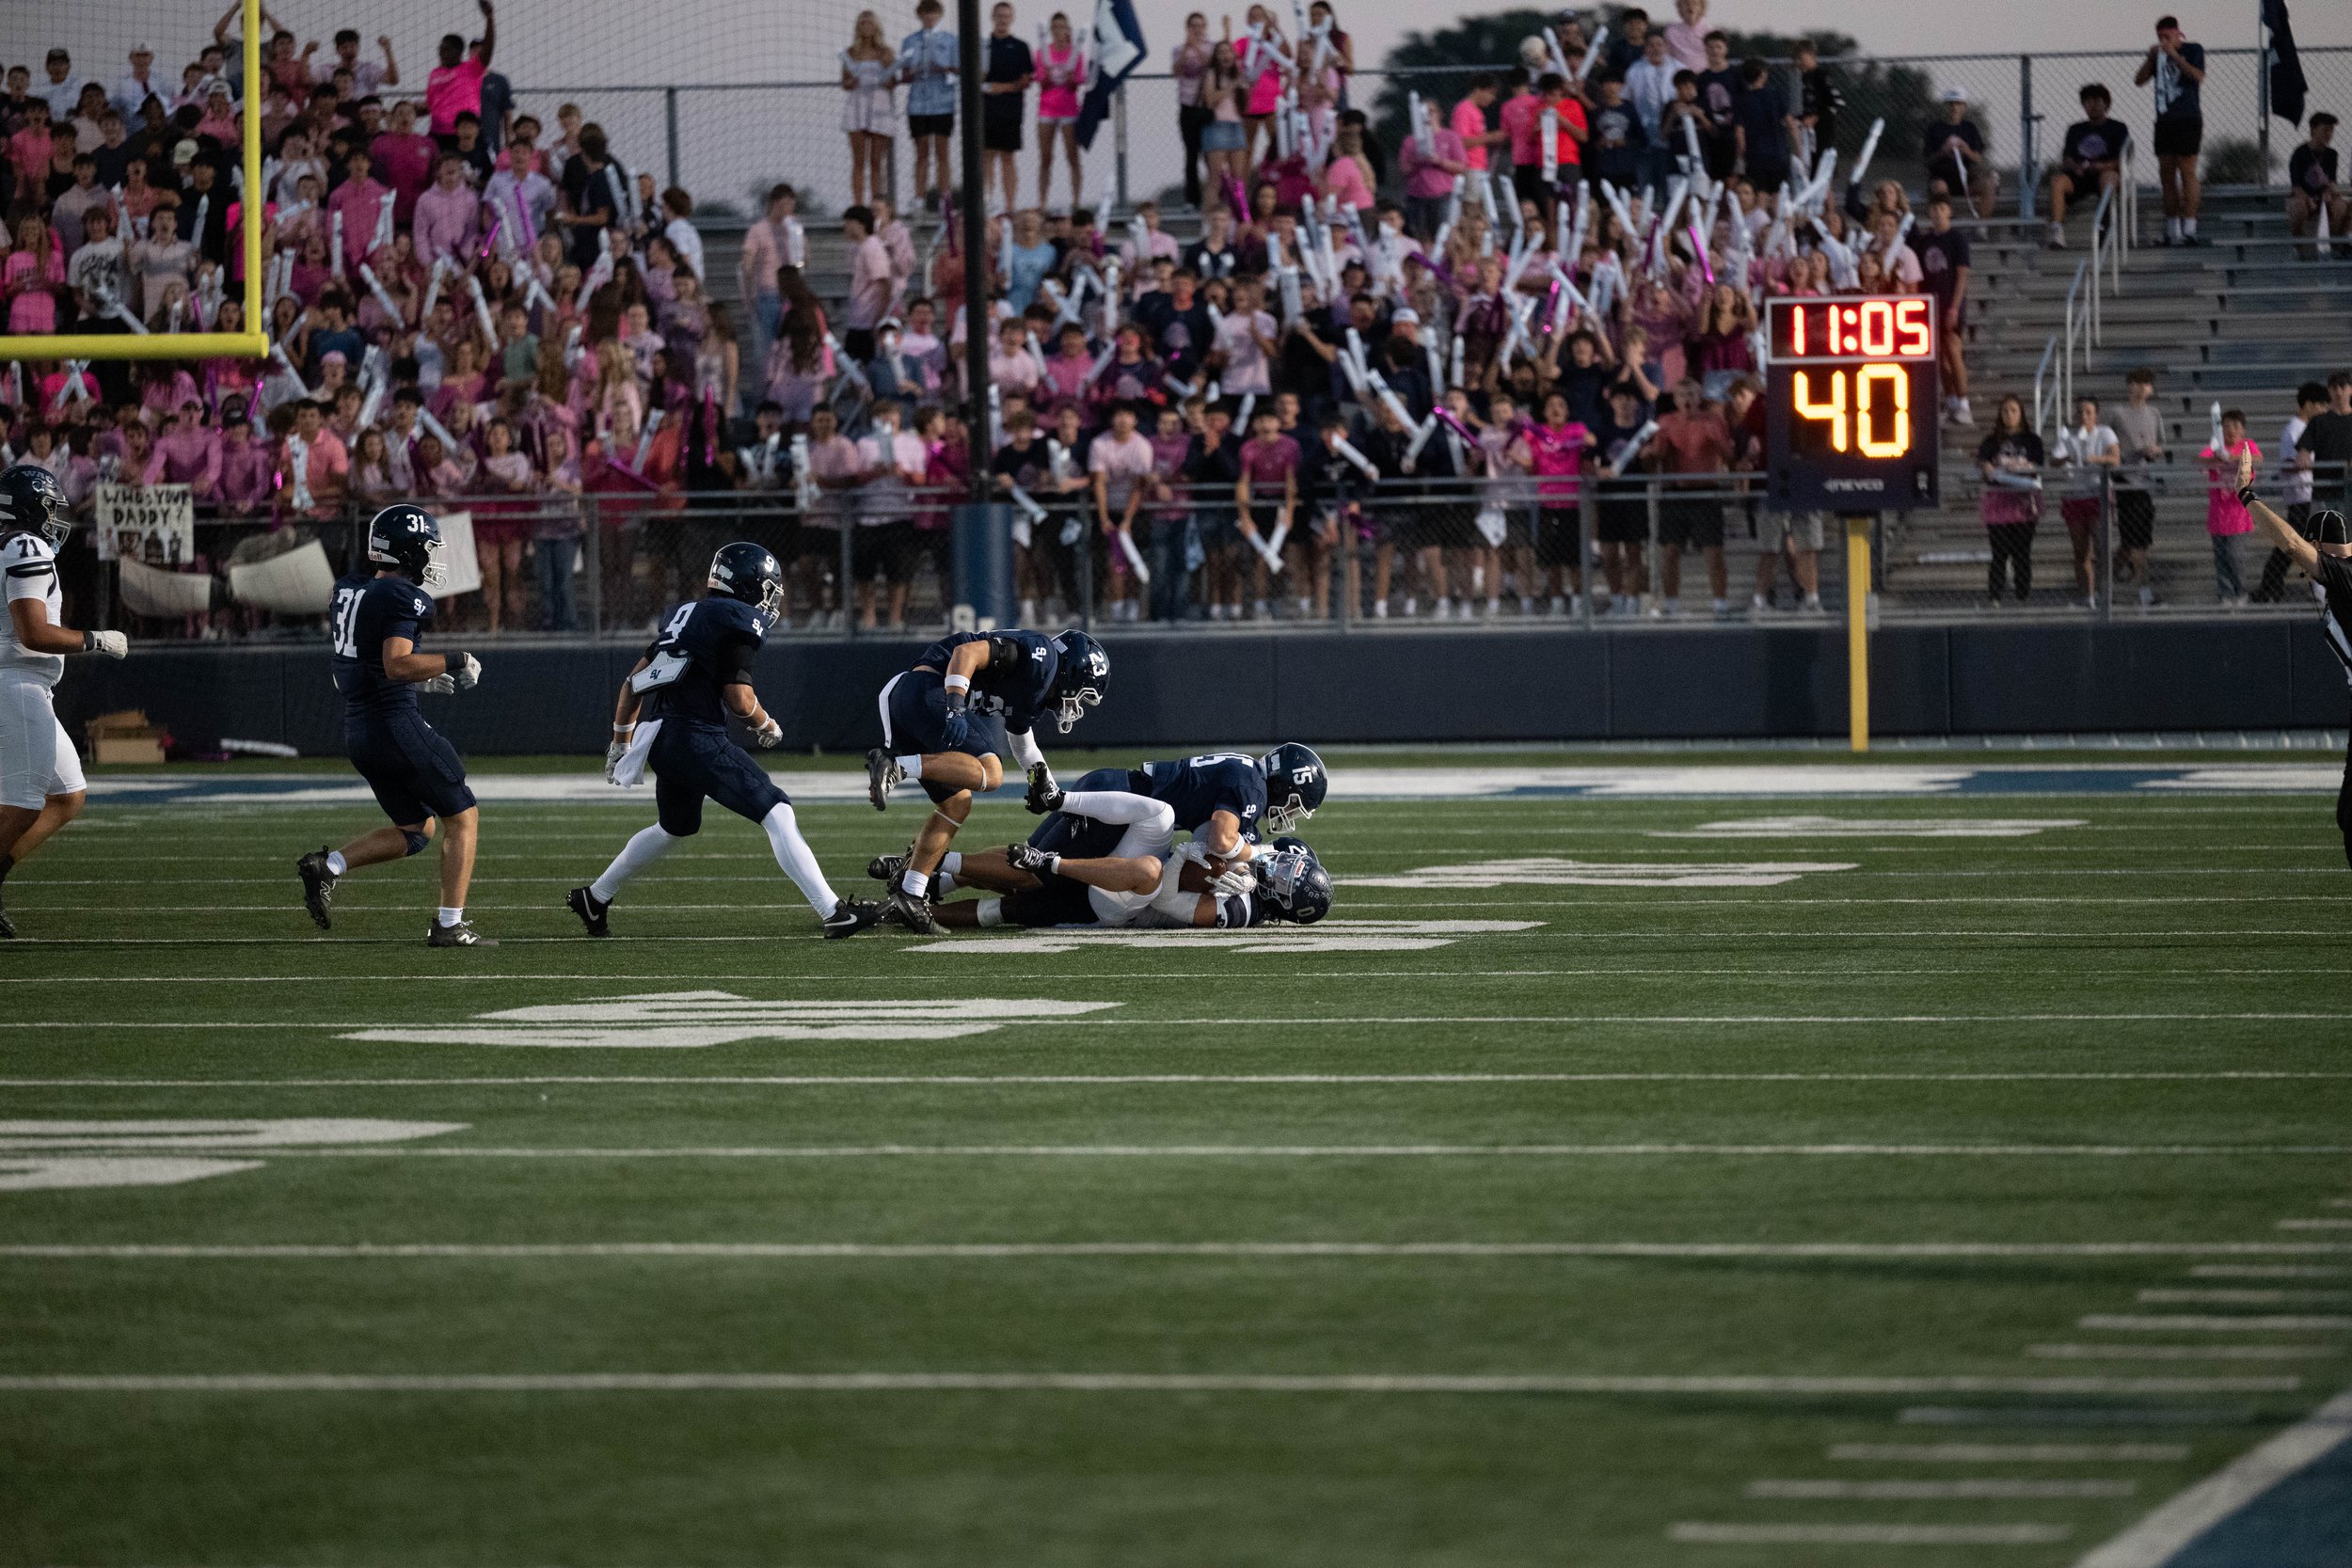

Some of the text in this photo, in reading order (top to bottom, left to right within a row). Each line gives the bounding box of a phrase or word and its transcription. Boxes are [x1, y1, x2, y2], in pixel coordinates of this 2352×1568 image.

[1793, 301, 1929, 356] 11:05
[1794, 364, 1908, 458] 40
[406, 514, 424, 533] 31
[16, 538, 42, 558] 71
[764, 555, 775, 572] 9
[333, 588, 367, 658] 31
[1089, 651, 1107, 677] 23
[1292, 765, 1313, 785] 15
